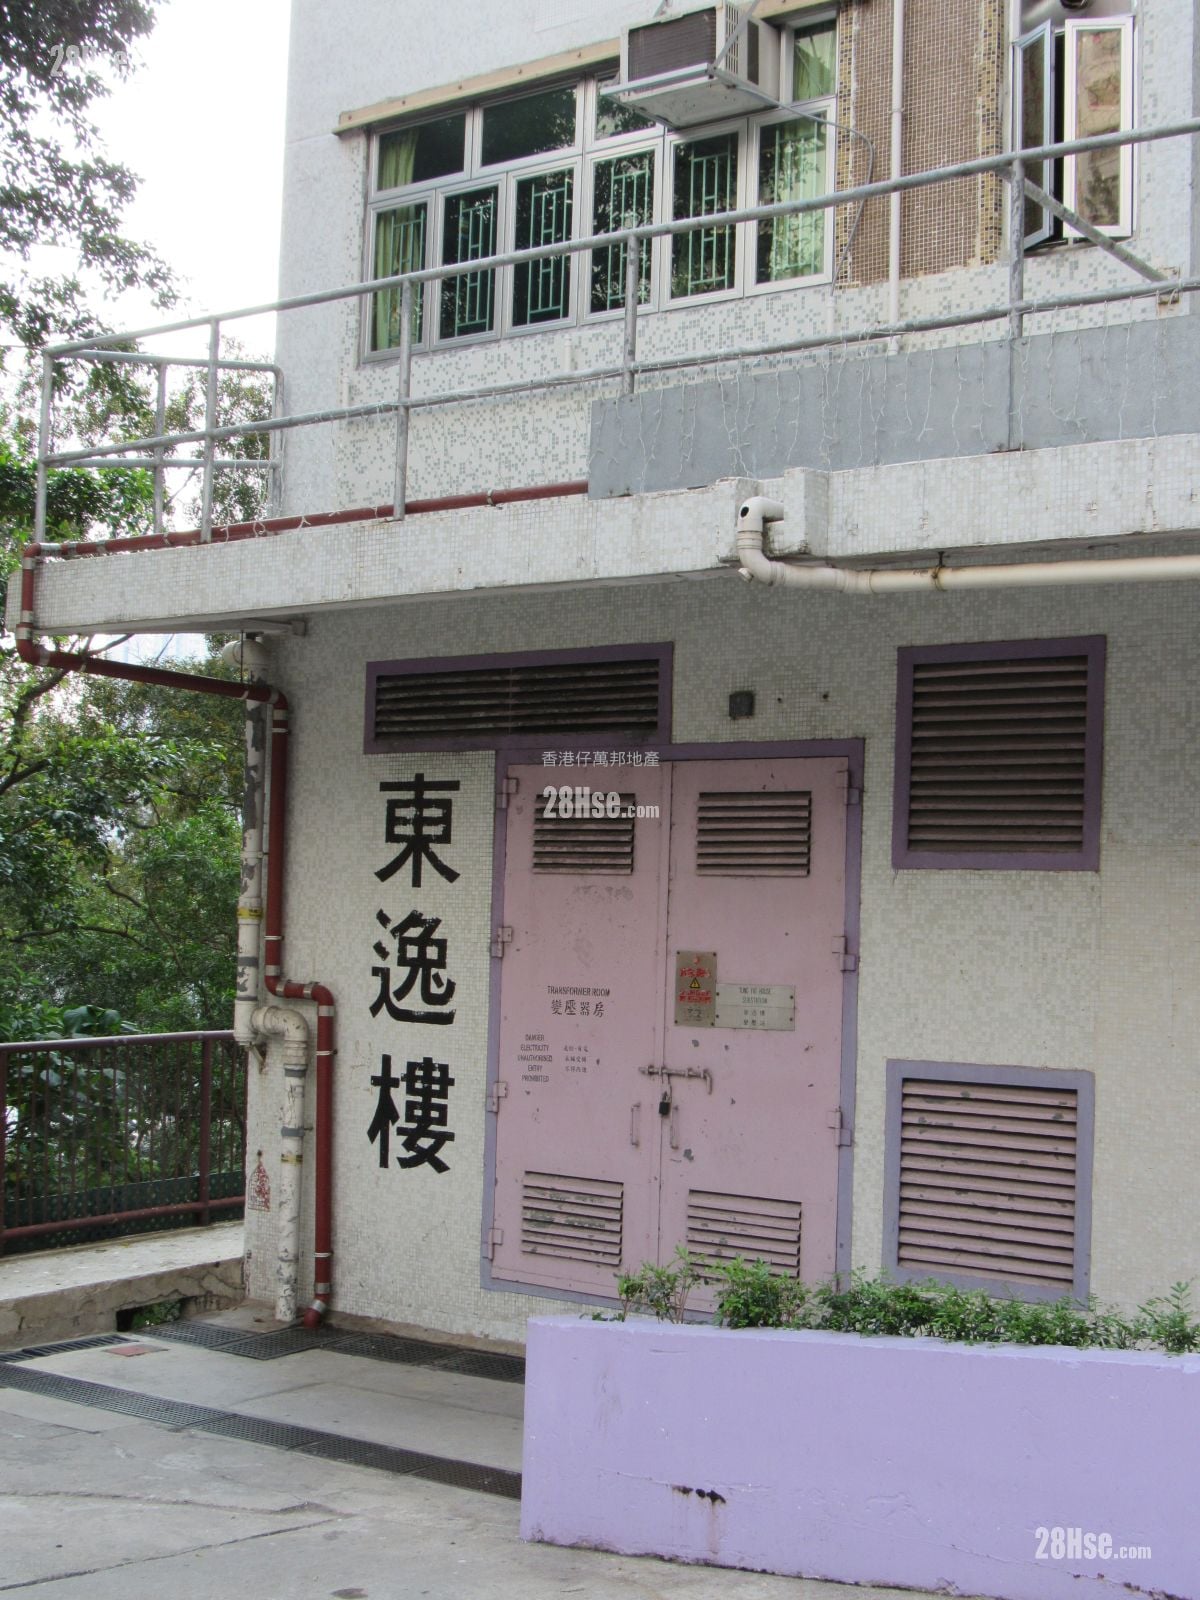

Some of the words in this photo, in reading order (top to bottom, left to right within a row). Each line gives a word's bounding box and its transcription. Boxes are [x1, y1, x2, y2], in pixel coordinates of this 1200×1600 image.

[367, 772, 461, 1174] 東逸樓
[592, 987, 611, 997] ROOM
